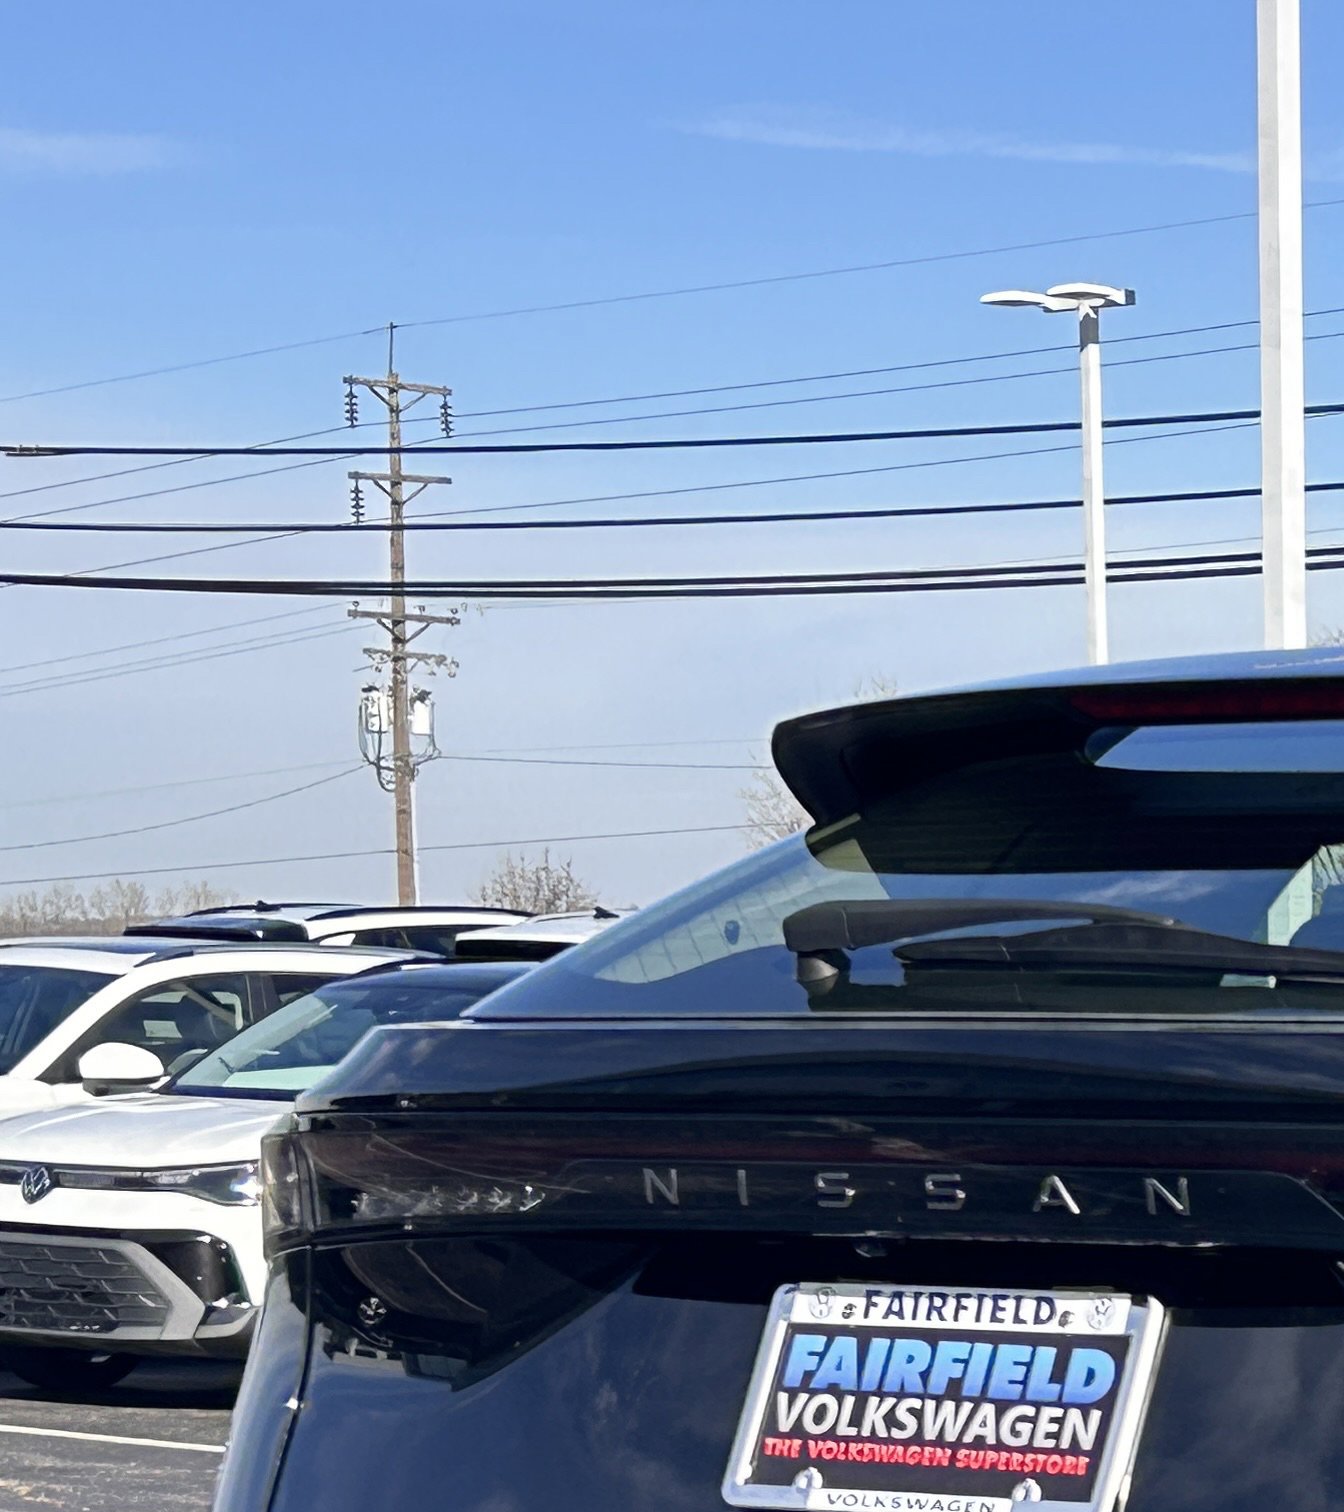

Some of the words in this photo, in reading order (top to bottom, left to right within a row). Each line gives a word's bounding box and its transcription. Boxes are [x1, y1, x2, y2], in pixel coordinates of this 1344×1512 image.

[642, 1167, 1191, 1217] NISSAN
[863, 1289, 1057, 1325] FAIRFIELD
[783, 1334, 1115, 1404] FAIRFIELD
[777, 1391, 1102, 1450] VOLKSWAGEN
[764, 1437, 802, 1459] THE
[808, 1440, 952, 1466] VOLKSWAGEN
[955, 1449, 1090, 1476] SUPERSTORE
